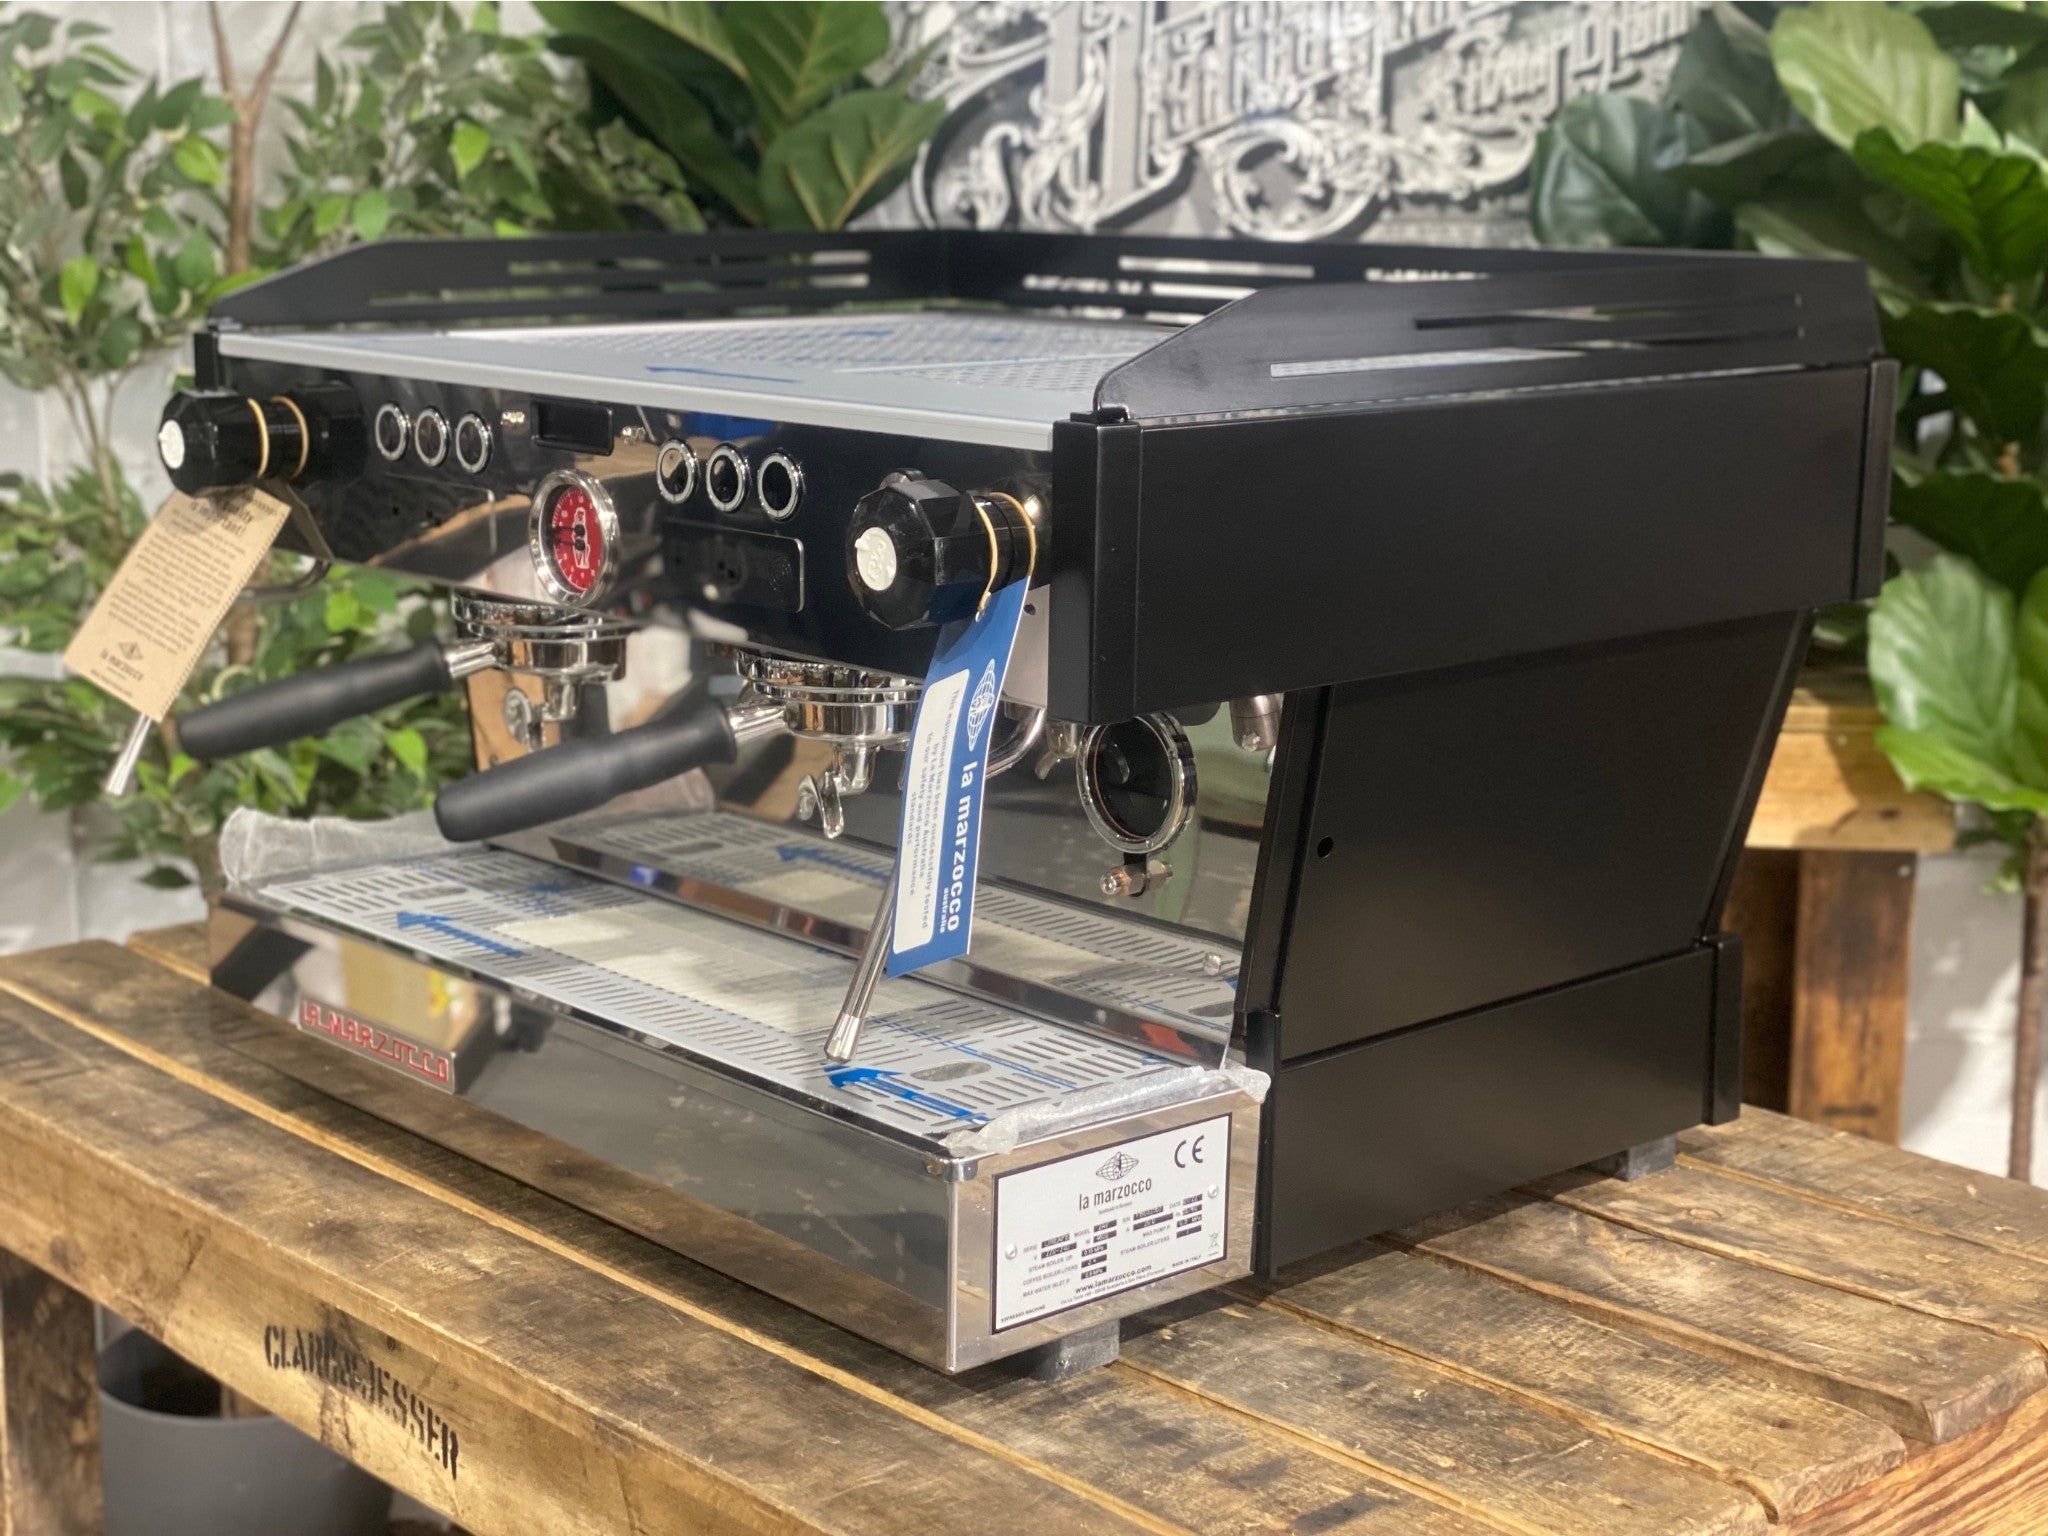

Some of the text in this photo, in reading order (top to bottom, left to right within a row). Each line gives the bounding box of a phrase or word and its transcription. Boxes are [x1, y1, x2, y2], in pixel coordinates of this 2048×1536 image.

[926, 732, 934, 744] to
[918, 767, 929, 800] safety
[924, 774, 936, 826] Marzocco
[907, 791, 917, 845] standards
[916, 803, 924, 822] and
[922, 690, 960, 929] This equipment has been successfully tested
[909, 825, 922, 896] performance
[920, 830, 930, 878] Australia
[948, 760, 978, 931] la marzocco
[940, 887, 950, 933] australia
[1079, 1194, 1089, 1210] la
[1094, 1178, 1152, 1206] marzocco
[1075, 1264, 1151, 1293] www.lamarzocco.com
